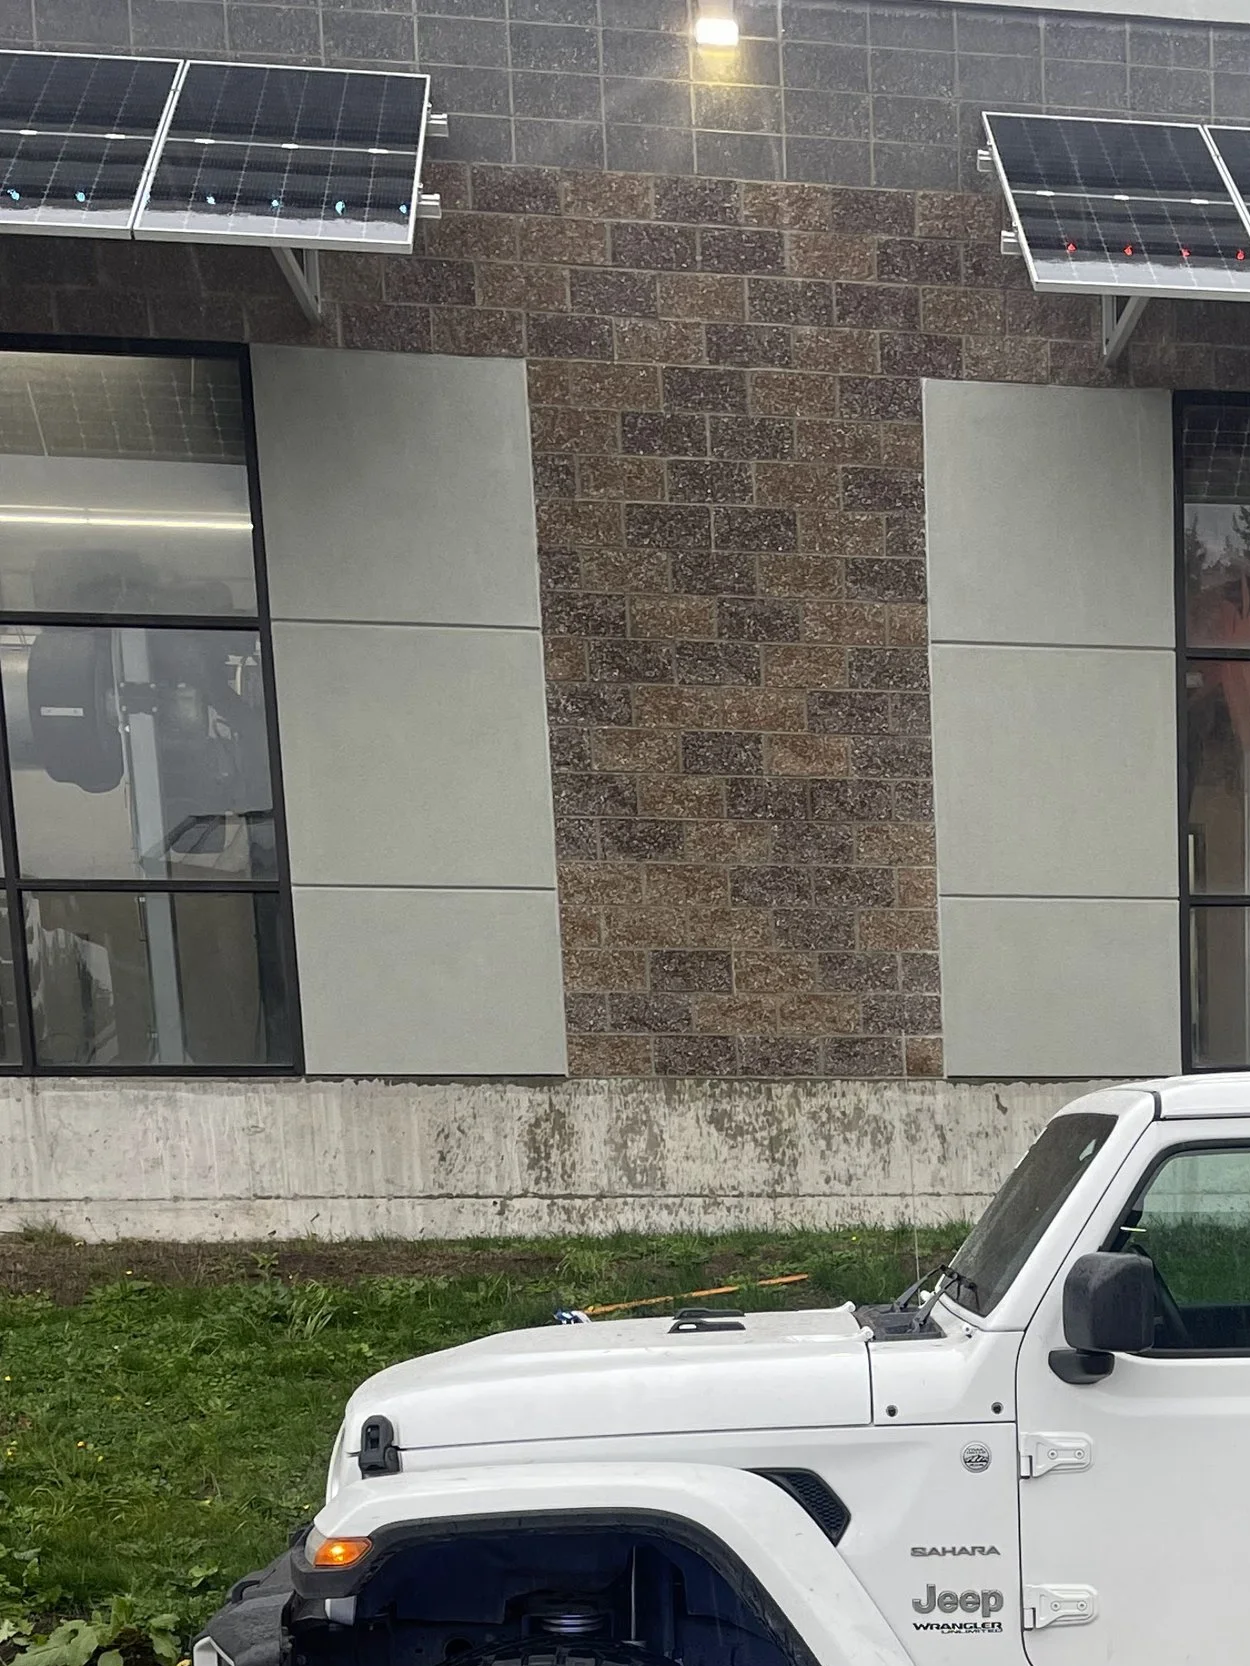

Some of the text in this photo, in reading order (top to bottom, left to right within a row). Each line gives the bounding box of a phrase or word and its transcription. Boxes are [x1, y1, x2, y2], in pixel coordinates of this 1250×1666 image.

[911, 1546, 1001, 1557] SAHARA
[912, 1584, 1004, 1618] Jeep
[912, 1622, 1003, 1631] WRANGLER
